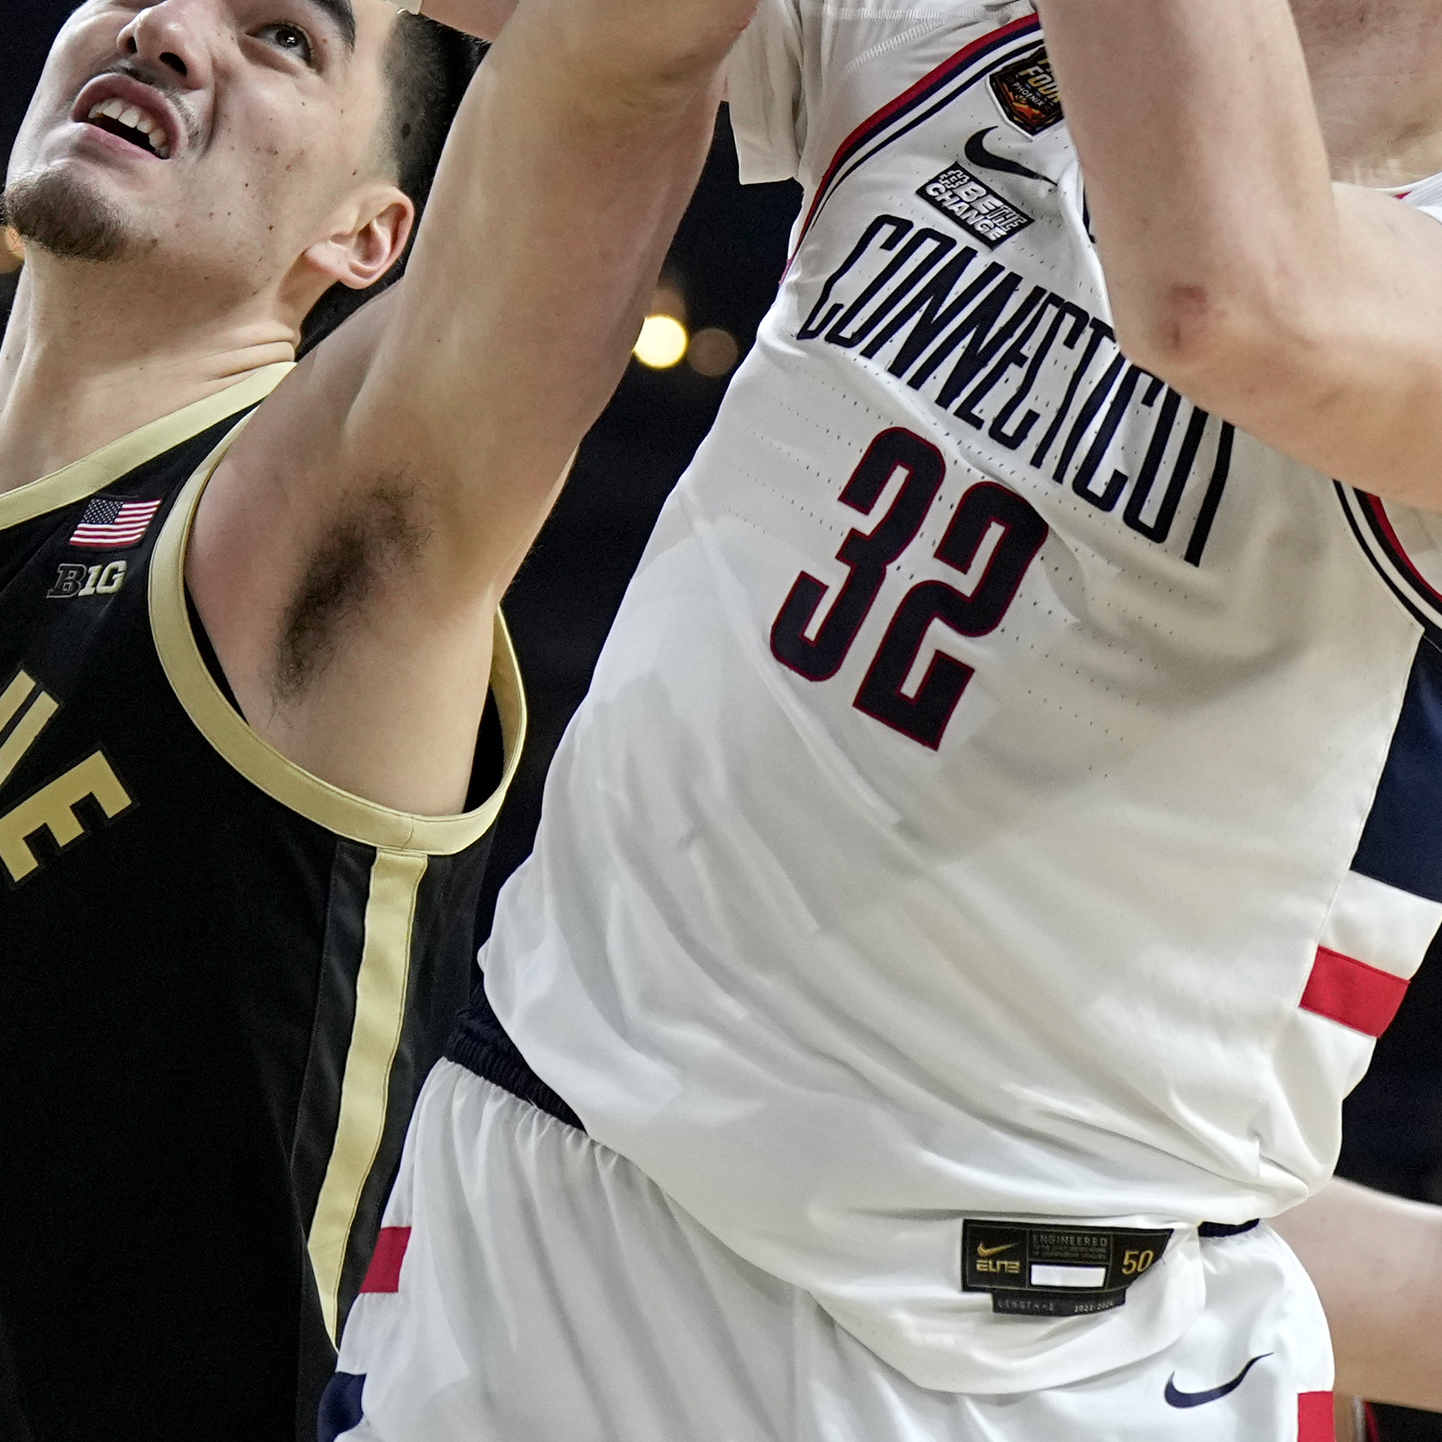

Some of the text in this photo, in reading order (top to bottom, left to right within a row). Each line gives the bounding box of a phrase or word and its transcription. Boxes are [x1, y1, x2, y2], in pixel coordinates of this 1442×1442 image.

[1012, 81, 1045, 106] PHOENIX
[925, 182, 1007, 242] CHANGE
[769, 425, 1051, 754] 32
[1032, 1234, 1108, 1247] ENGINEERED
[976, 1259, 1020, 1274] ELITE
[1121, 1250, 1154, 1275] 50
